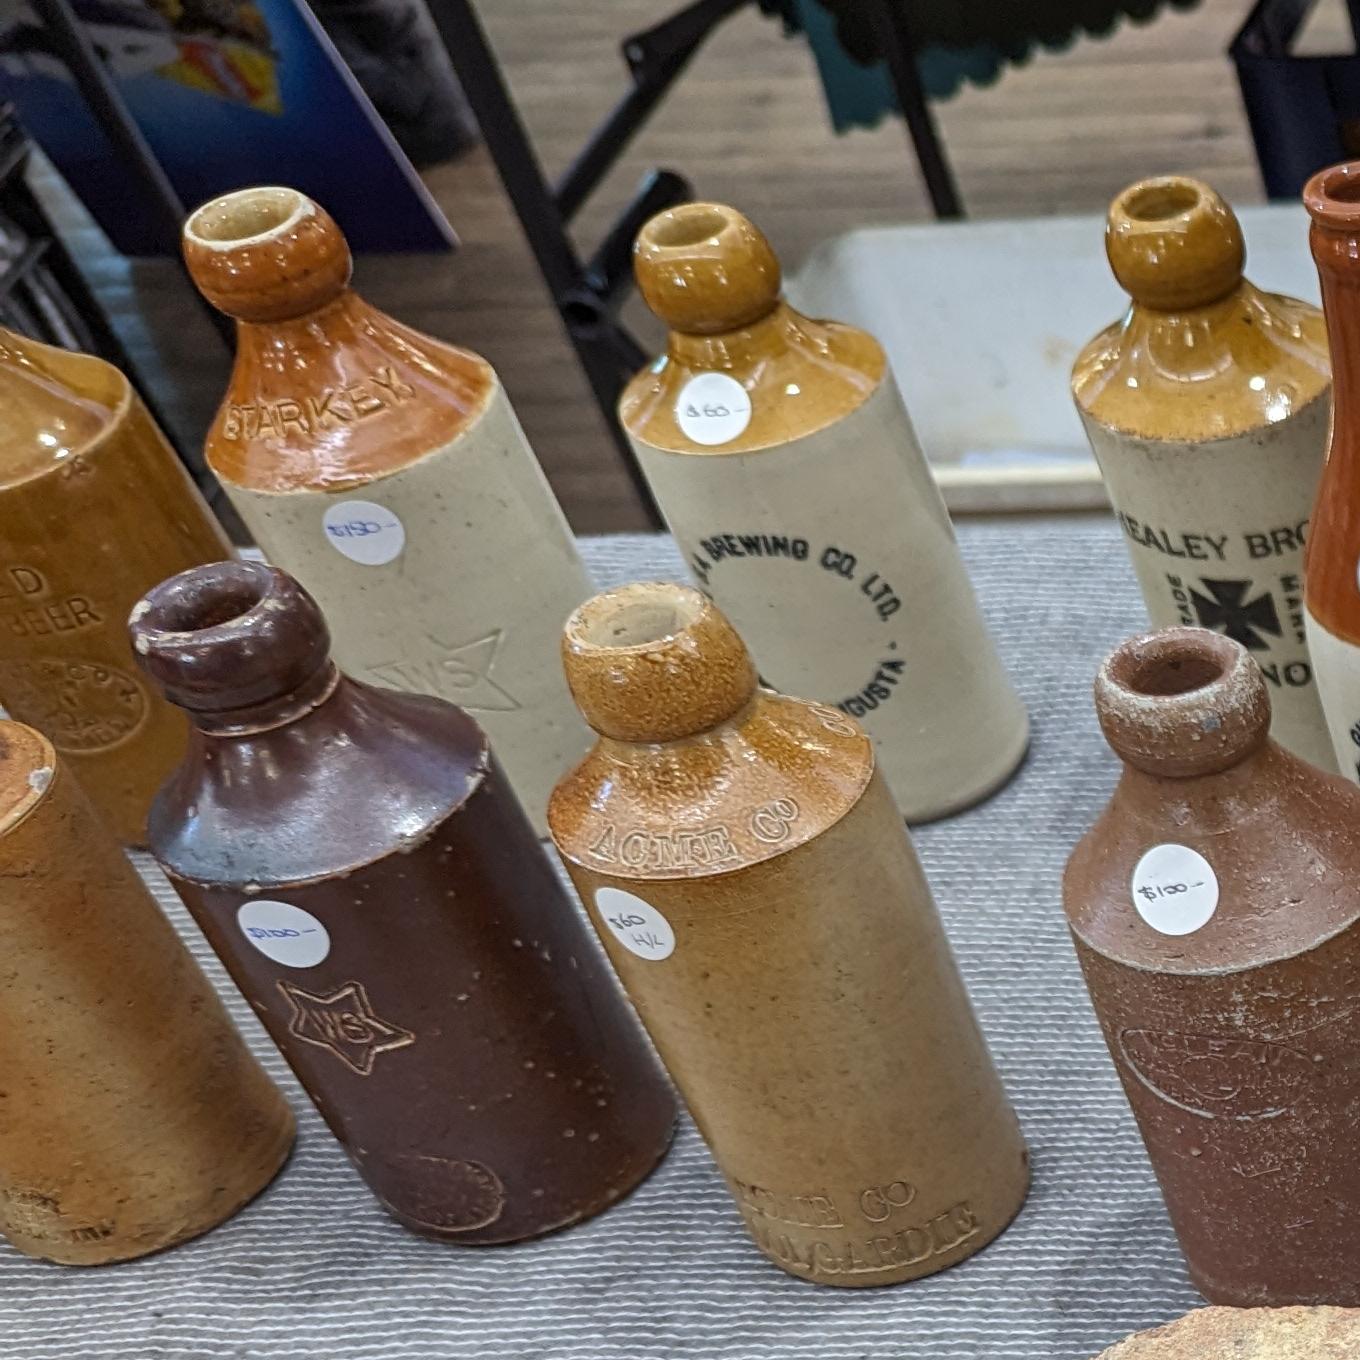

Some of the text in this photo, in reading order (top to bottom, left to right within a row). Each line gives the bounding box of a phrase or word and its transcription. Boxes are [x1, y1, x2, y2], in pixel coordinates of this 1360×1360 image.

[700, 534, 810, 563] BREWING
[589, 823, 738, 870] ACME
[766, 1201, 983, 1275] LGARDIE
